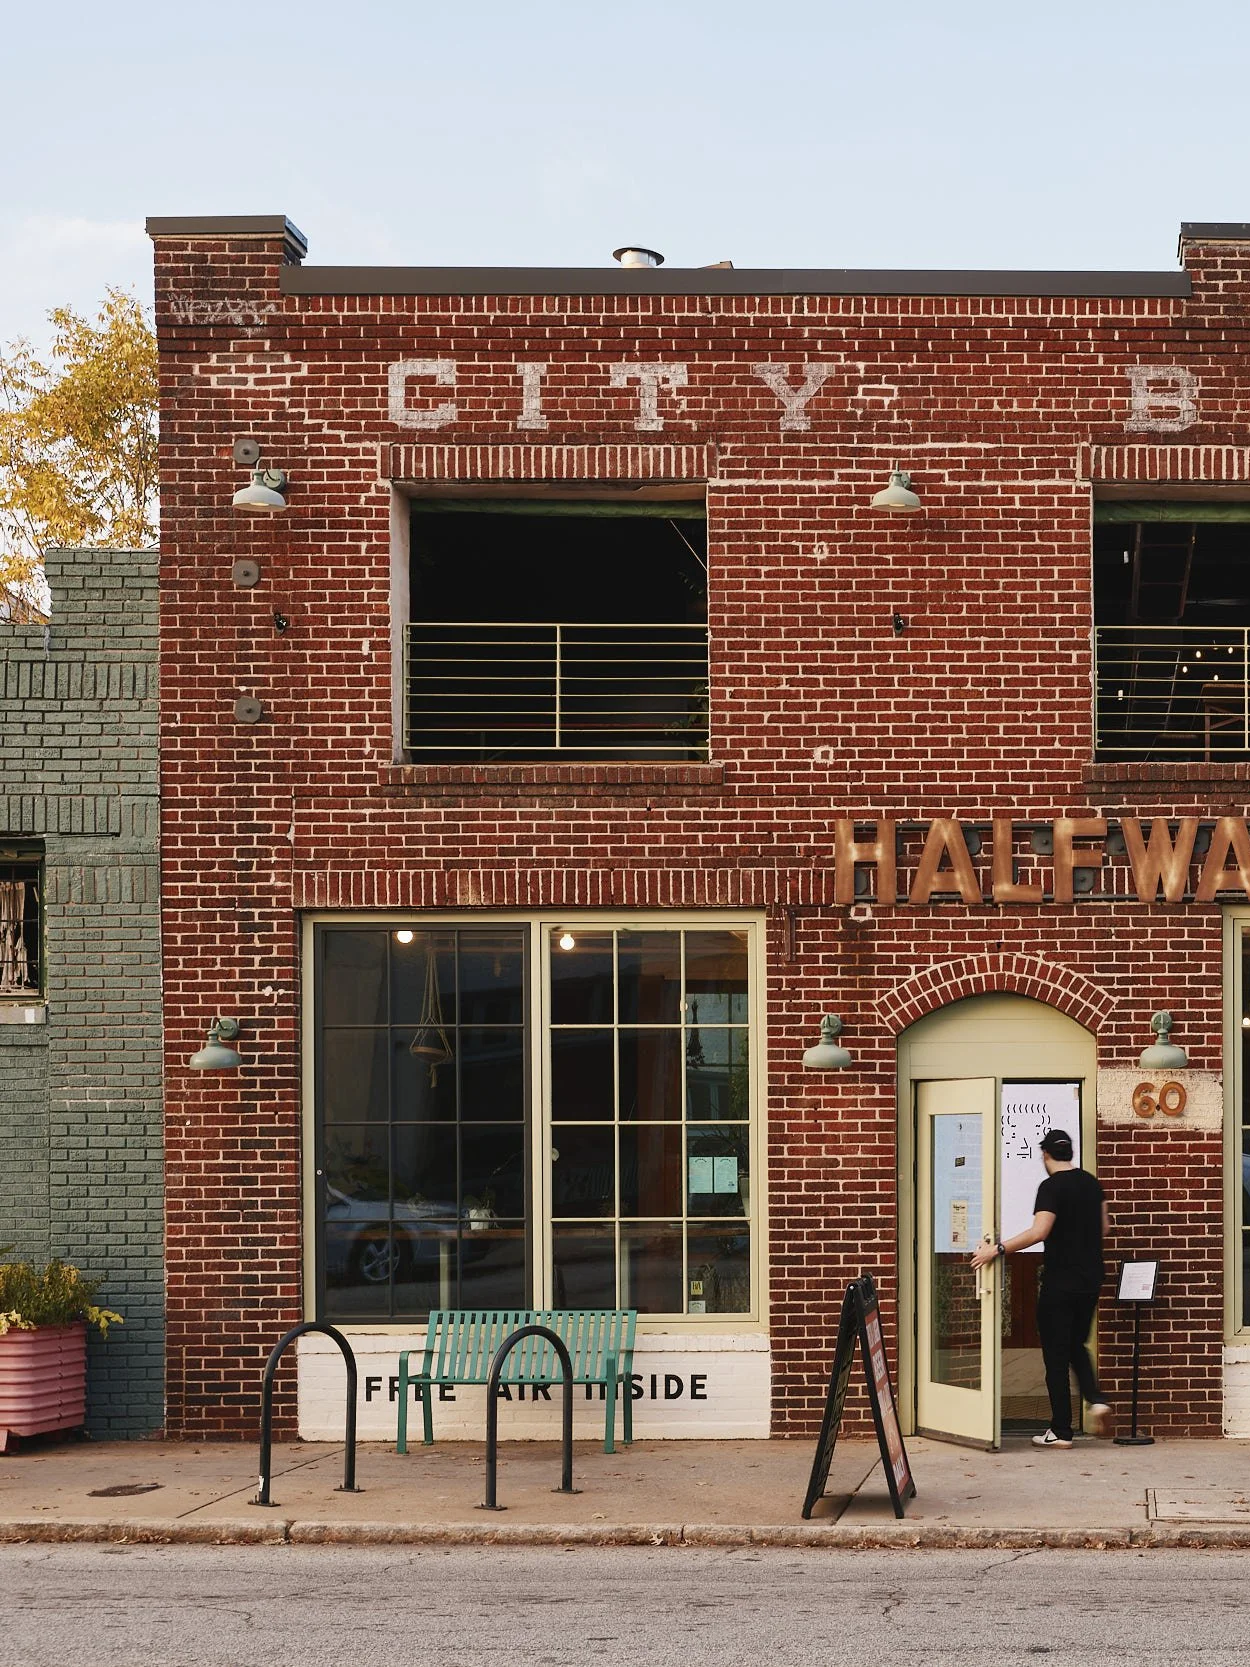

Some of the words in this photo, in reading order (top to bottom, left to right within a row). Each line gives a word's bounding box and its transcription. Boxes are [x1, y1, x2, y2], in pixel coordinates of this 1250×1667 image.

[388, 359, 835, 431] CITY
[1132, 1081, 1187, 1118] 60
[495, 1374, 552, 1401] AIR
